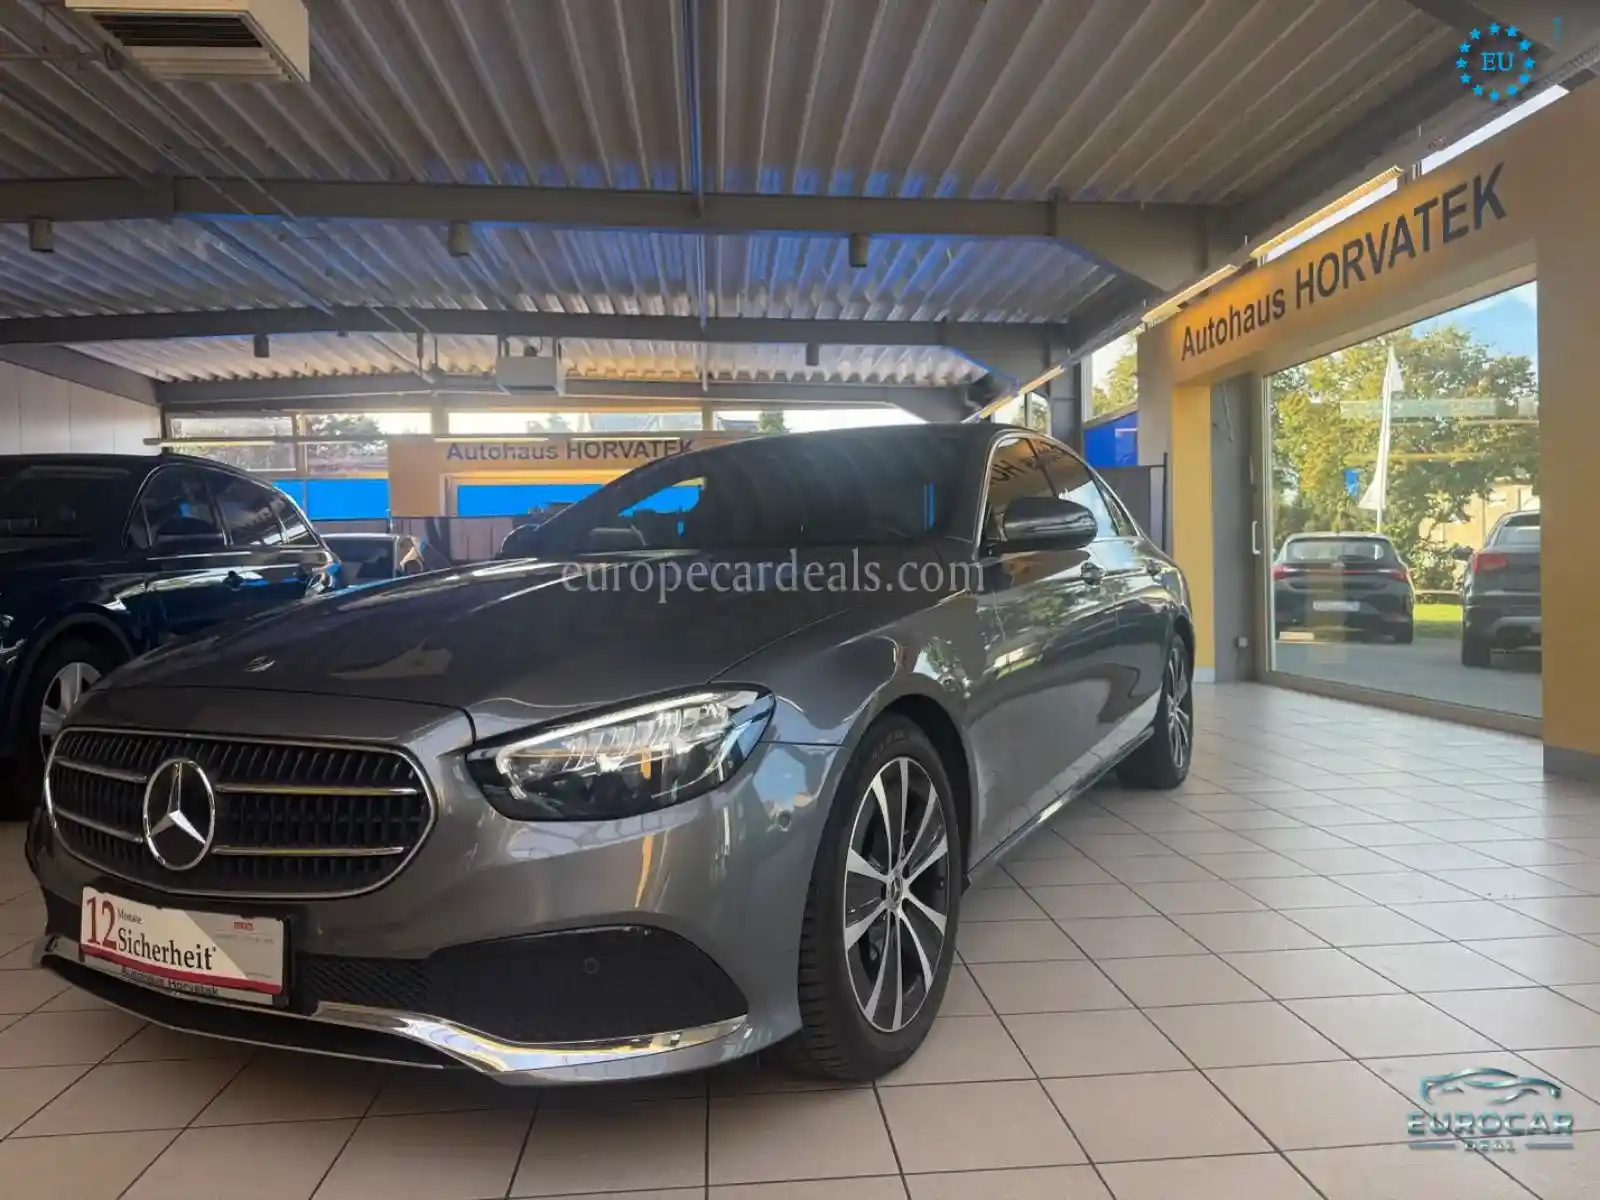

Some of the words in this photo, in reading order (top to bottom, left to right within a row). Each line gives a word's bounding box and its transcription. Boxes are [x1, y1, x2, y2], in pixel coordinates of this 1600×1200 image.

[1181, 287, 1286, 362] Autohaus
[1295, 162, 1507, 310] HORVATEK
[446, 442, 558, 460] Autohaus
[566, 440, 695, 459] HORVATEK
[86, 897, 117, 951] 12
